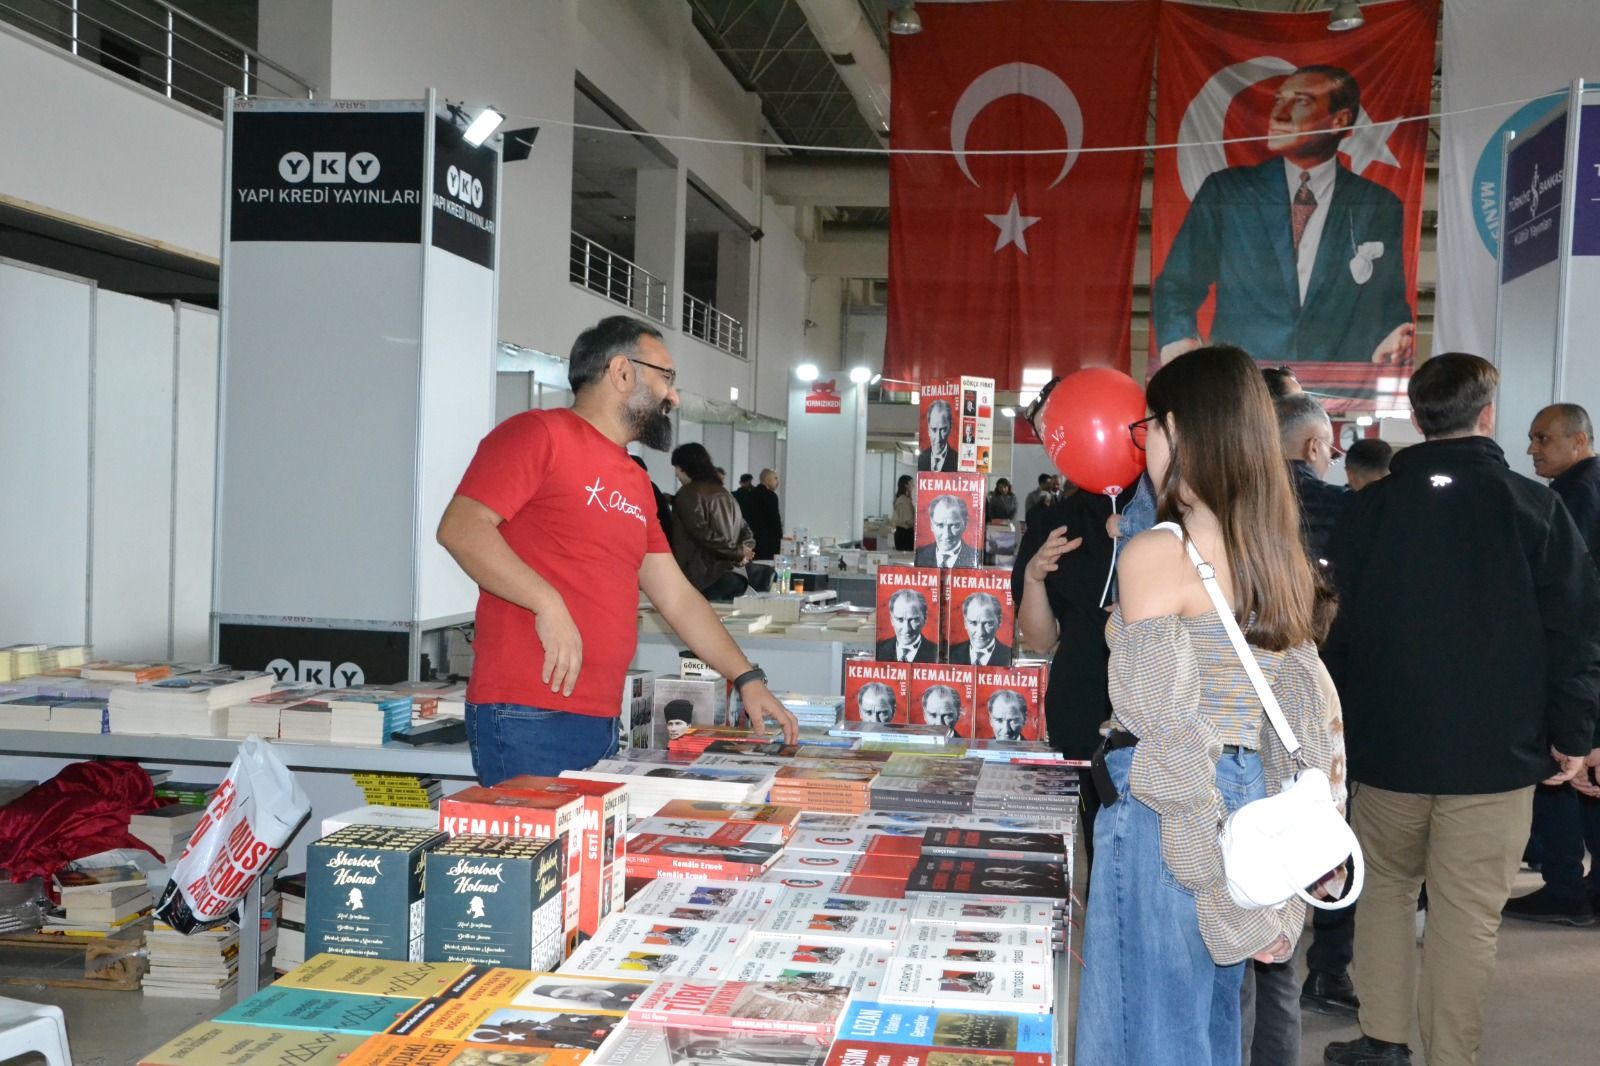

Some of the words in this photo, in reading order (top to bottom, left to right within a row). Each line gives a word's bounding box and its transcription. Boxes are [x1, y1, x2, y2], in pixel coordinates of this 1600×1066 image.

[282, 155, 377, 179] YKY
[449, 168, 482, 205] YKY
[238, 189, 274, 203] YAPI
[279, 187, 329, 203] KREDİ
[333, 189, 420, 204] YAYINLARI
[921, 381, 960, 397] KEMALİZM
[920, 477, 979, 492] KEMALİZM
[879, 571, 938, 587] KEMALİZM
[953, 575, 1012, 590] KEMALİZM
[269, 663, 361, 687] YKY
[683, 662, 704, 671] GÖKÇE
[848, 664, 907, 681] KEMALİZM
[913, 667, 972, 683] KEMALİZM
[978, 672, 1038, 688] KEMALİZM
[604, 797, 617, 812] GÖKÇE
[617, 792, 628, 804] FIRAT
[587, 834, 599, 860] SETİ
[326, 850, 384, 876] Sherlock
[446, 858, 506, 883] Sherlock
[672, 859, 699, 869] Kemâle
[701, 861, 723, 871] Ermek
[333, 868, 378, 886] Holmes
[657, 870, 684, 880] Kemâle
[685, 872, 708, 880] Ermek
[453, 876, 500, 894] Holmes
[662, 983, 718, 1012] TÜRK
[851, 1009, 883, 1036] LOZAN
